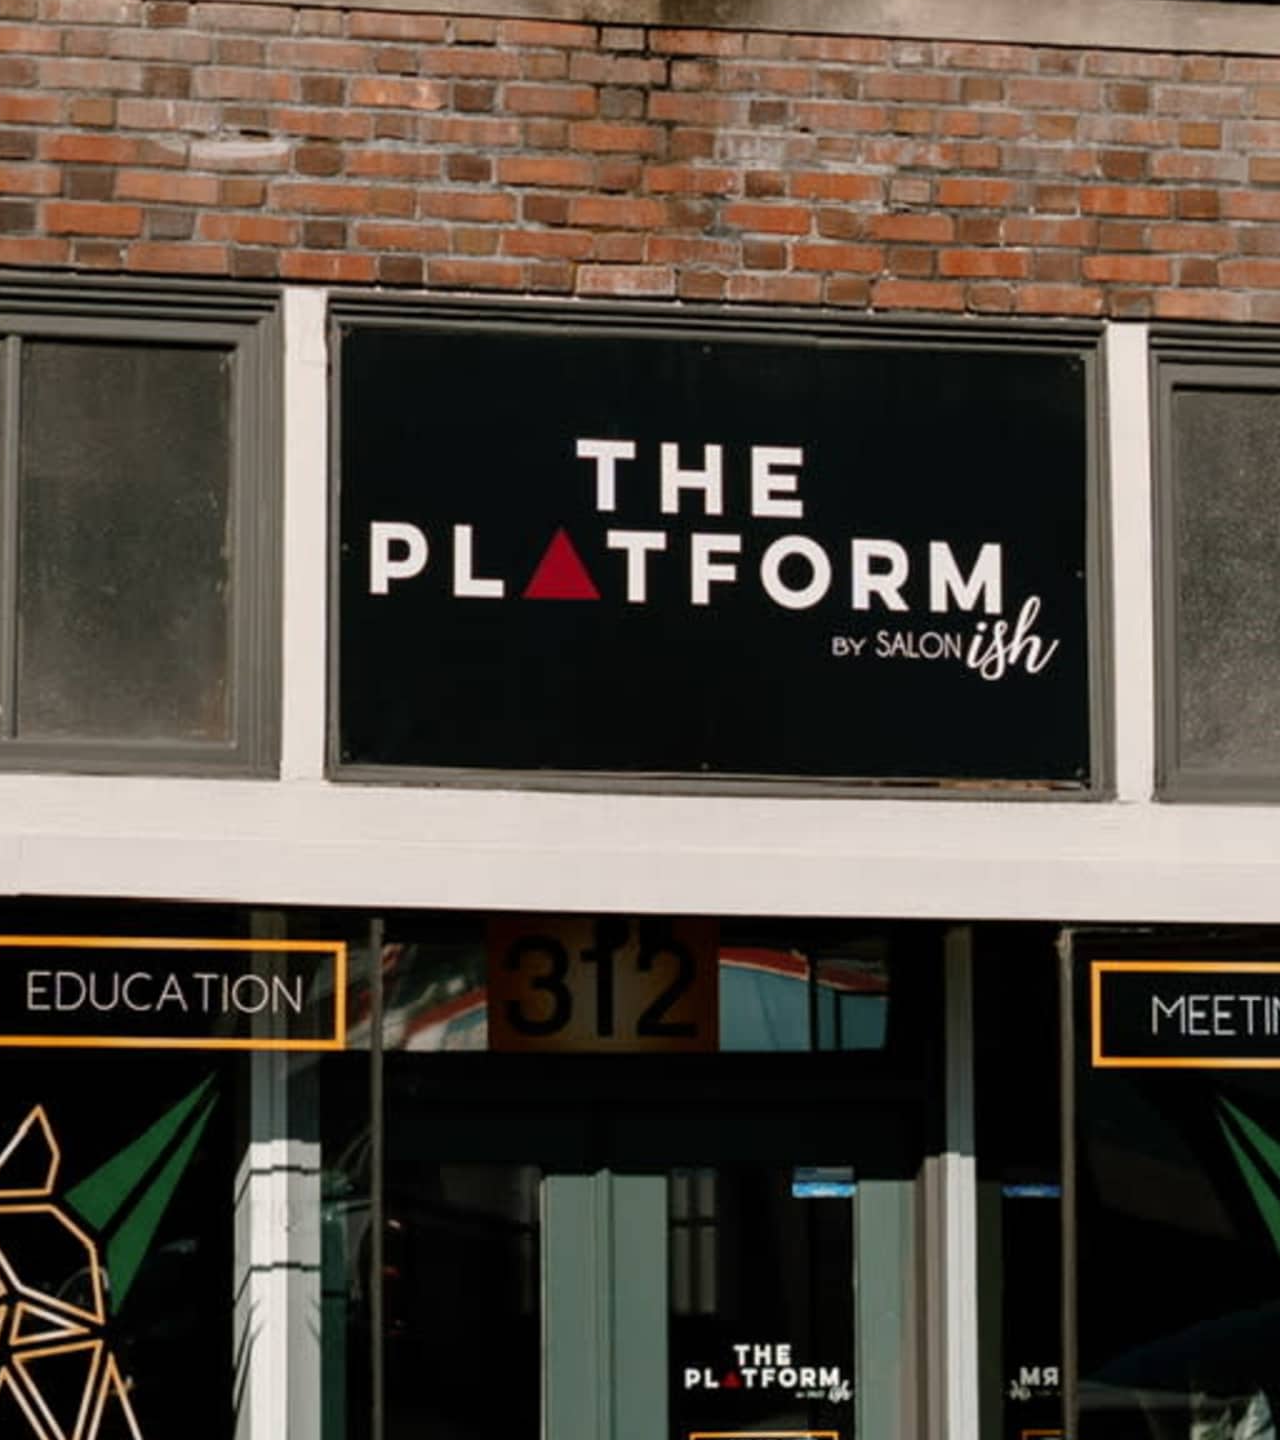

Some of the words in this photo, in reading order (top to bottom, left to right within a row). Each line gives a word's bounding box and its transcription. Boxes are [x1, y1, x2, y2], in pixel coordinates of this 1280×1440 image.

[576, 438, 804, 519] THE
[832, 636, 866, 657] BY
[26, 970, 304, 1016] EDUCATION
[504, 928, 699, 1038] 312
[733, 1343, 792, 1366] THE
